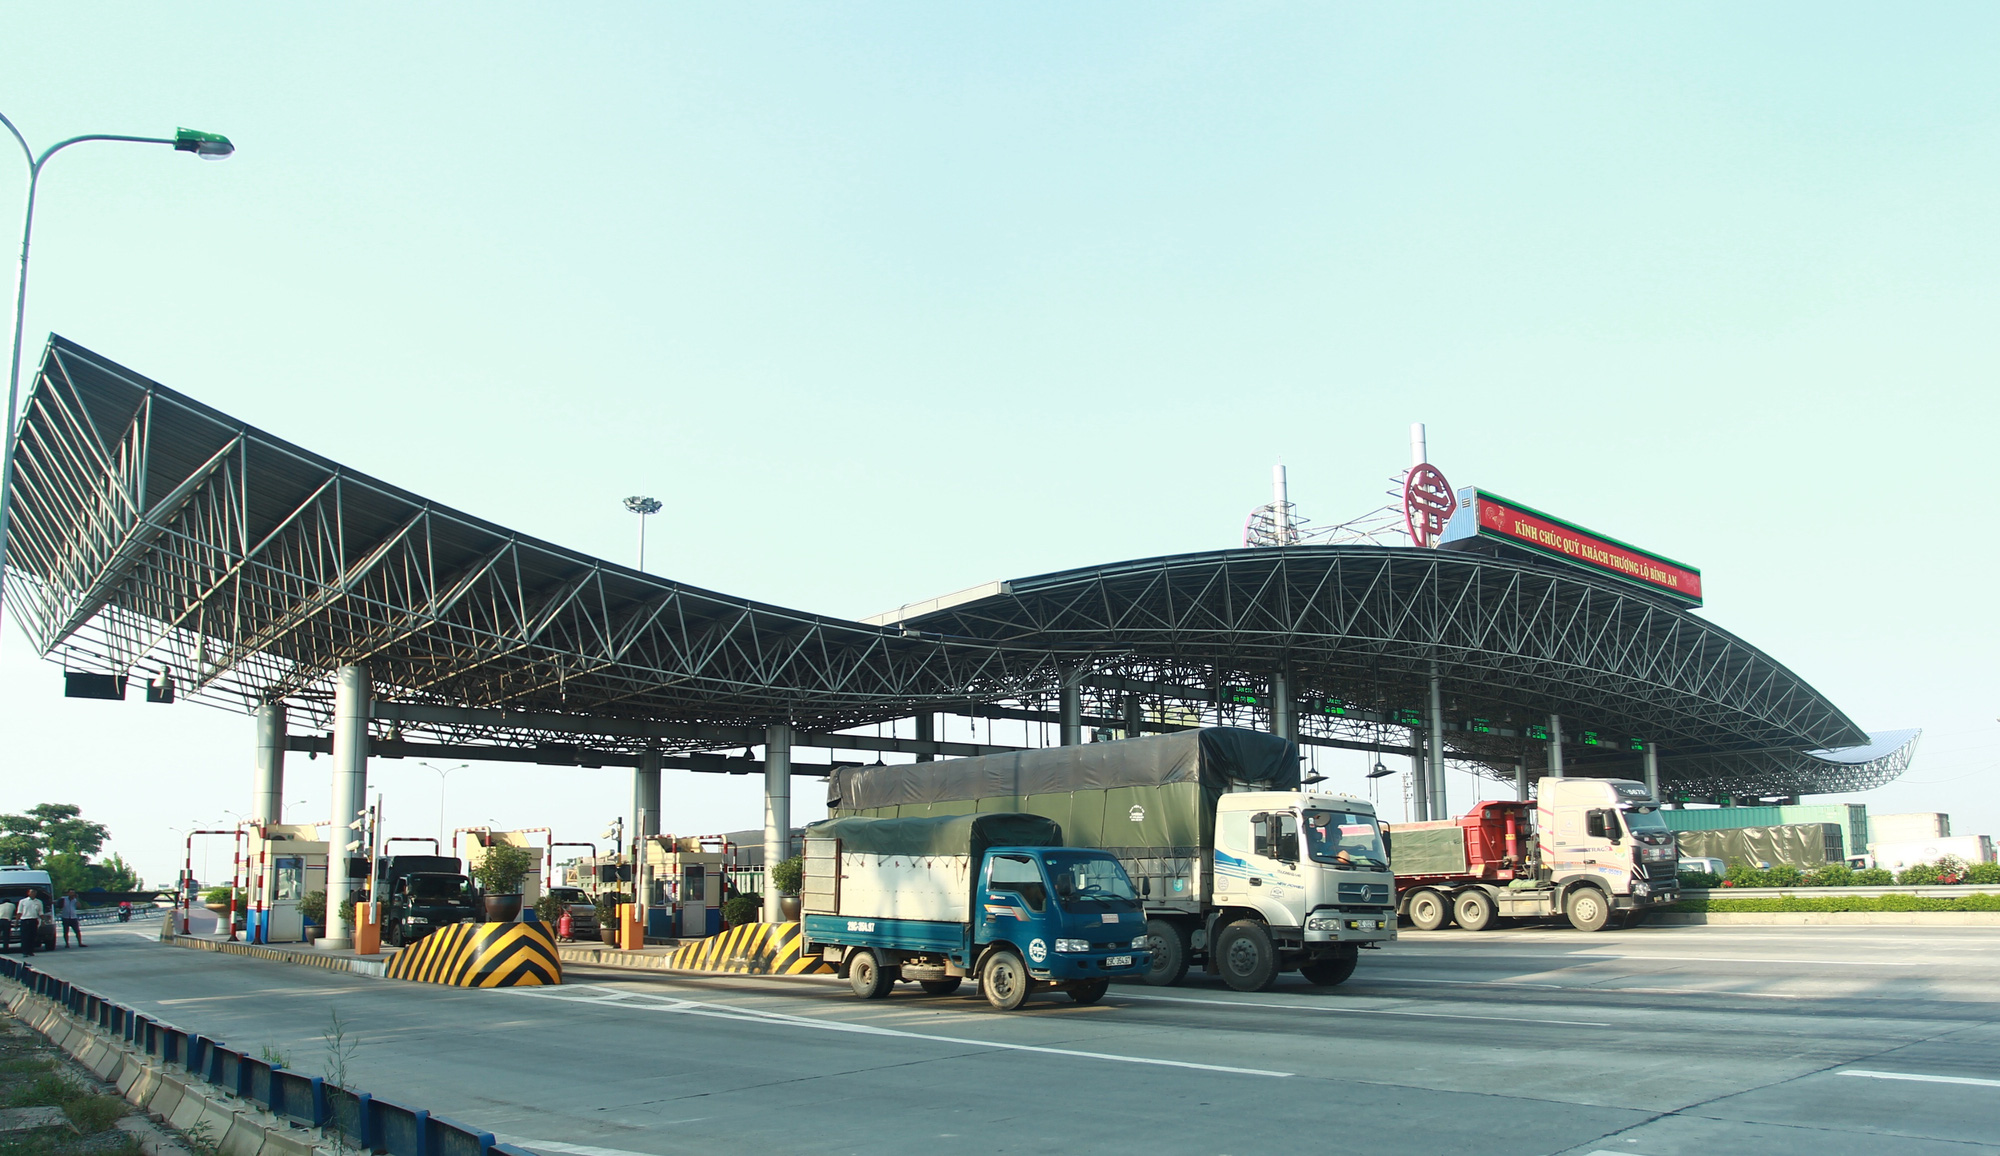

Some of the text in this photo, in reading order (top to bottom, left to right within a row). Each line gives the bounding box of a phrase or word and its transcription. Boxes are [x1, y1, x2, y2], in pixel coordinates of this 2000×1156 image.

[1515, 520, 1678, 587] KÍNH CHÚC QUÝ KHÁCH THƯỢNG LỘ BÌNH AN
